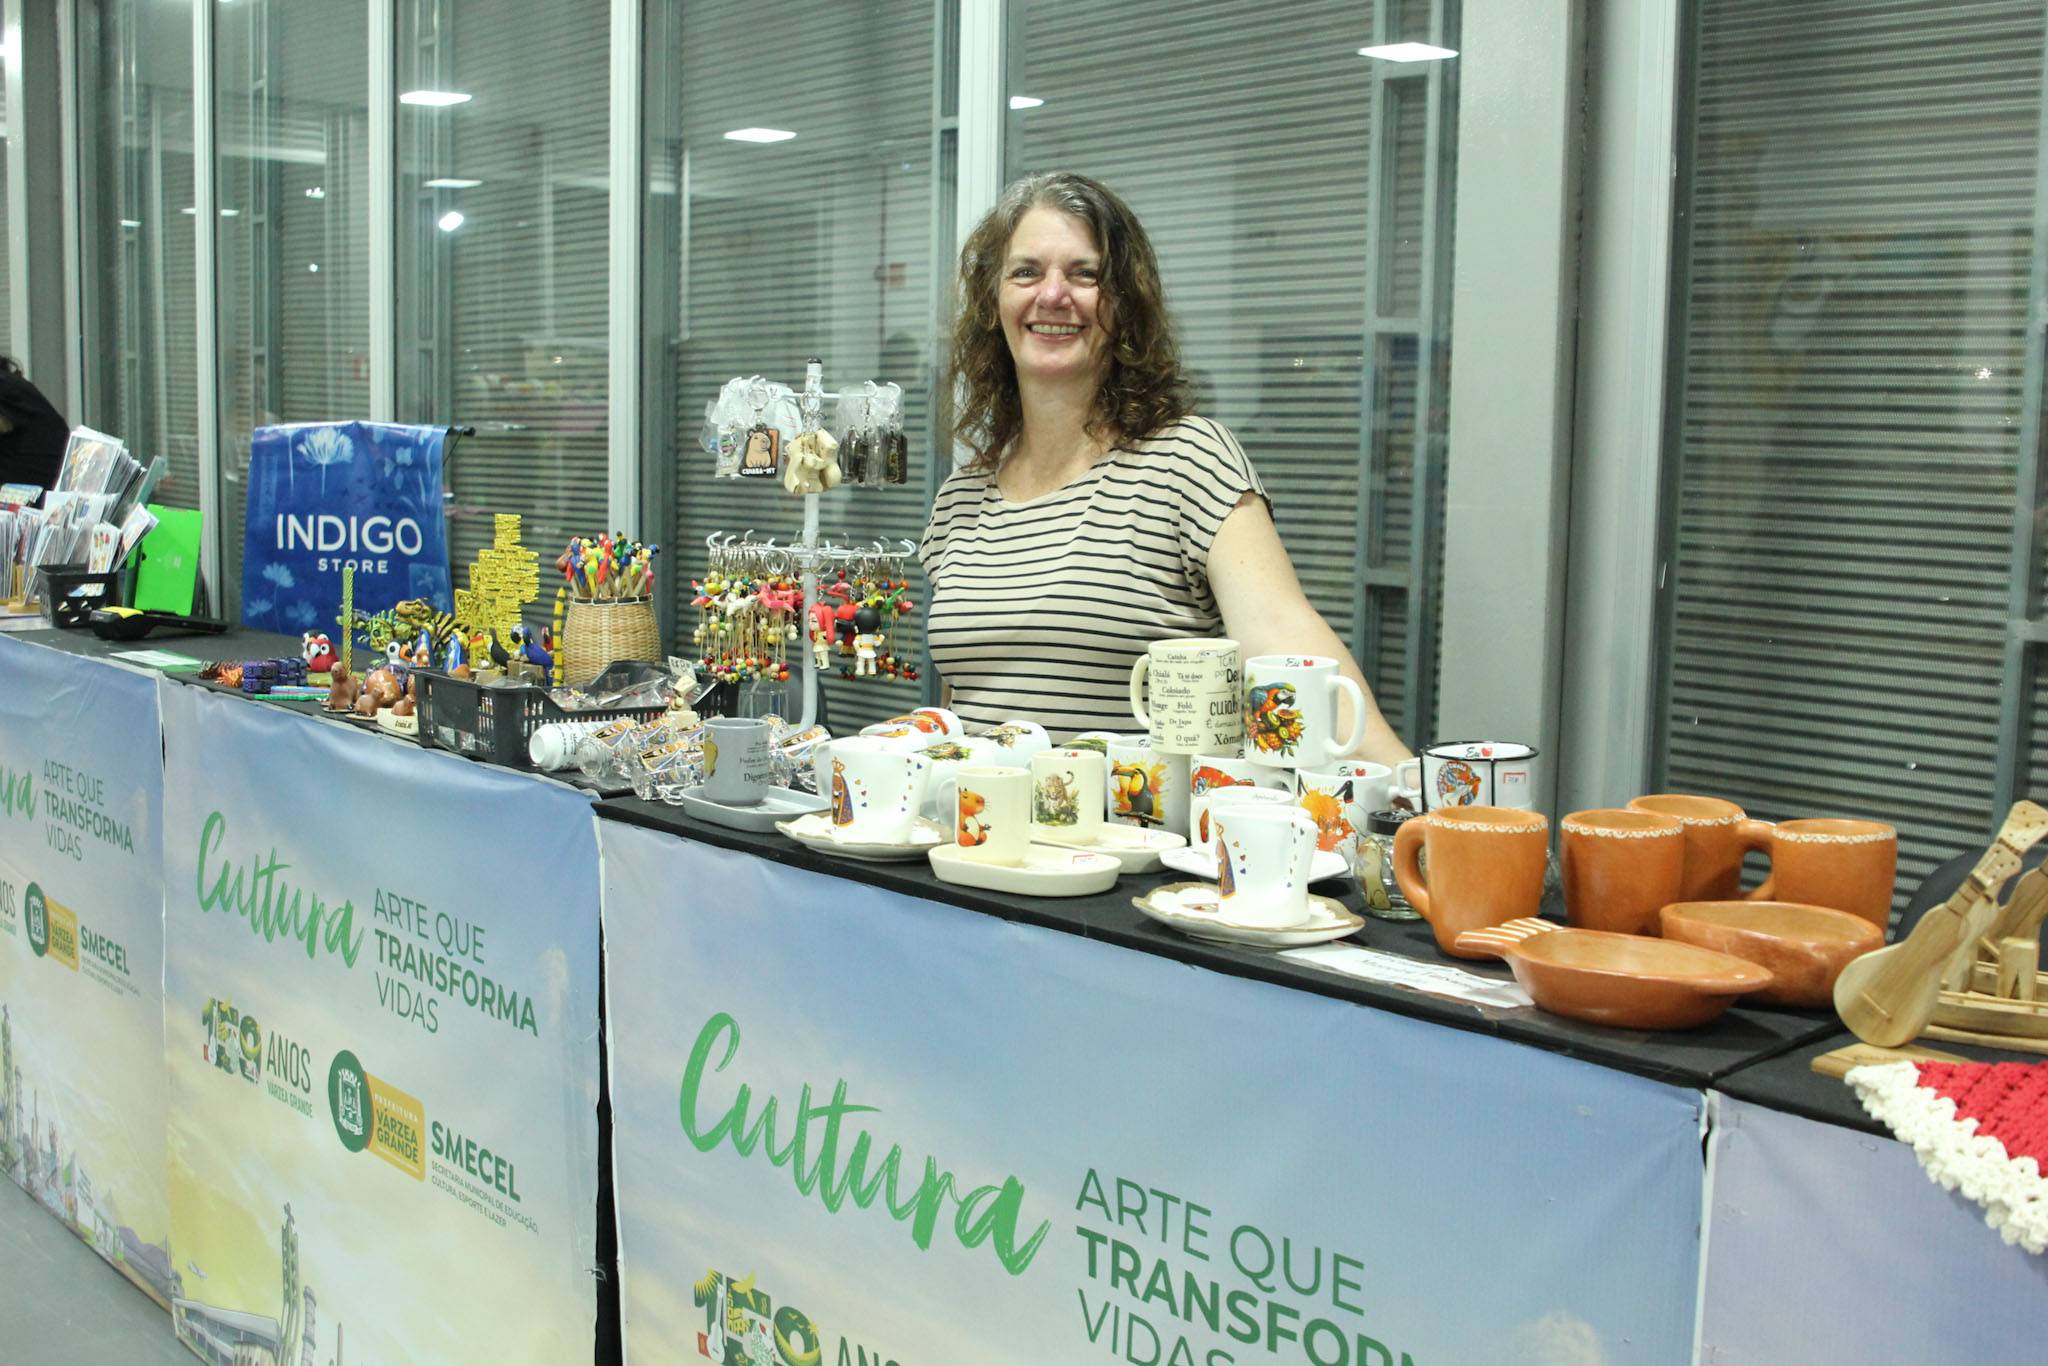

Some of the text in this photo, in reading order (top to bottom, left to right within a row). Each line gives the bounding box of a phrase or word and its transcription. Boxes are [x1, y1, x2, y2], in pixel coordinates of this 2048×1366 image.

[277, 513, 423, 556] INDIGO
[318, 558, 388, 574] STORE
[43, 760, 105, 807] ARTE QUE
[44, 790, 134, 854] TRANSFORMA
[45, 821, 83, 862] VIDAS
[197, 811, 364, 968] Cultura
[81, 925, 130, 975] SMECEL
[374, 888, 485, 964] ARTE QUE
[374, 929, 538, 1036] TRANSFORMA
[376, 971, 438, 1033] VIDAS
[267, 1031, 311, 1094] ANOS
[376, 1108, 418, 1146] VÁRZEA
[377, 1129, 419, 1164] GRANDE
[679, 1012, 1052, 1276] Cultura
[431, 1120, 521, 1202] SMECEL
[432, 1160, 464, 1187] SECRETARIA
[465, 1182, 495, 1207] MUNICIPAL
[1075, 1167, 1365, 1317] ARTE QUE
